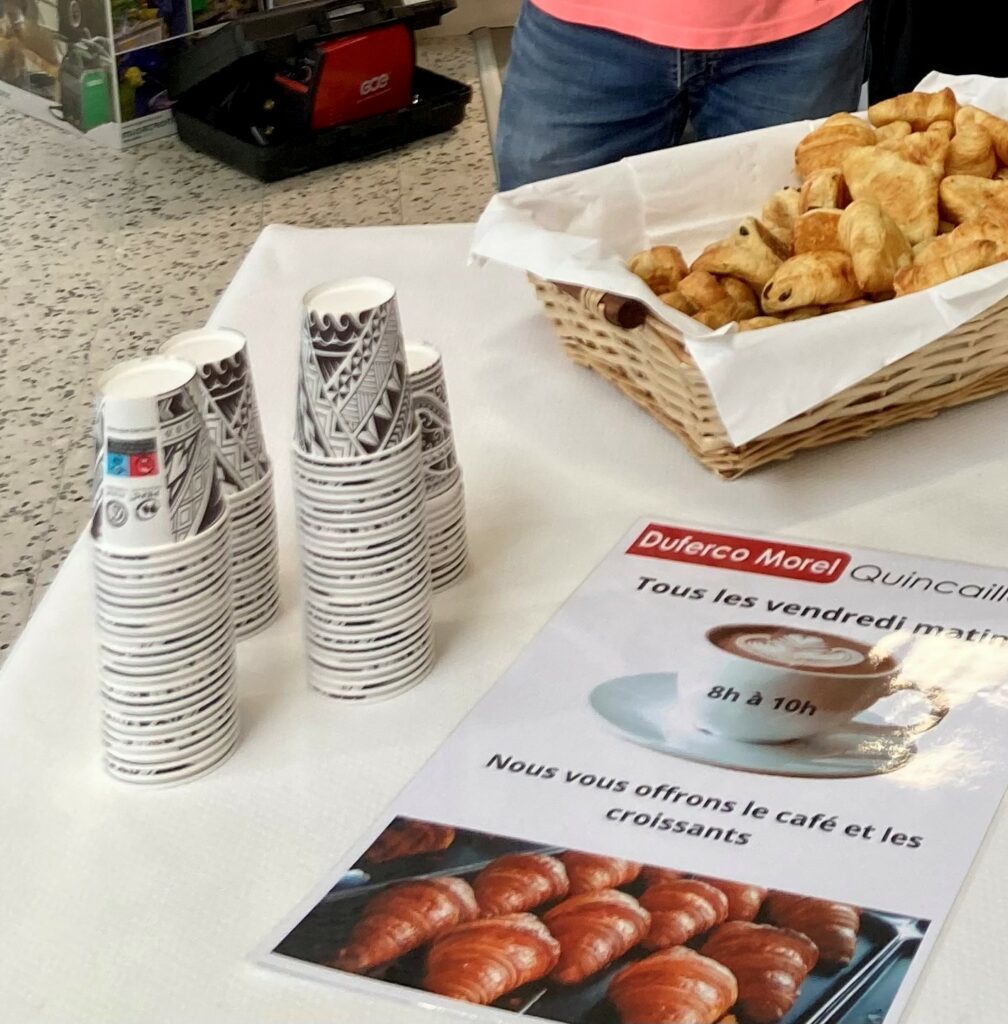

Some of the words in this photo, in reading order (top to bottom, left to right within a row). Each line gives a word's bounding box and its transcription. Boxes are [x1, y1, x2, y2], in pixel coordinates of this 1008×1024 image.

[639, 530, 750, 562] Duferco
[754, 548, 842, 576] Morel
[636, 576, 707, 600] Tous
[713, 589, 758, 609] les
[767, 600, 908, 631] vendredi
[707, 685, 741, 702] 8h
[746, 691, 763, 706] à
[773, 697, 818, 716] 10h
[485, 753, 559, 779] Nous
[565, 770, 630, 792] vous
[635, 784, 737, 813] offrons
[742, 801, 769, 819] le
[775, 809, 839, 832] café
[844, 824, 876, 839] et
[880, 827, 924, 849] les
[605, 807, 752, 846] croissants
